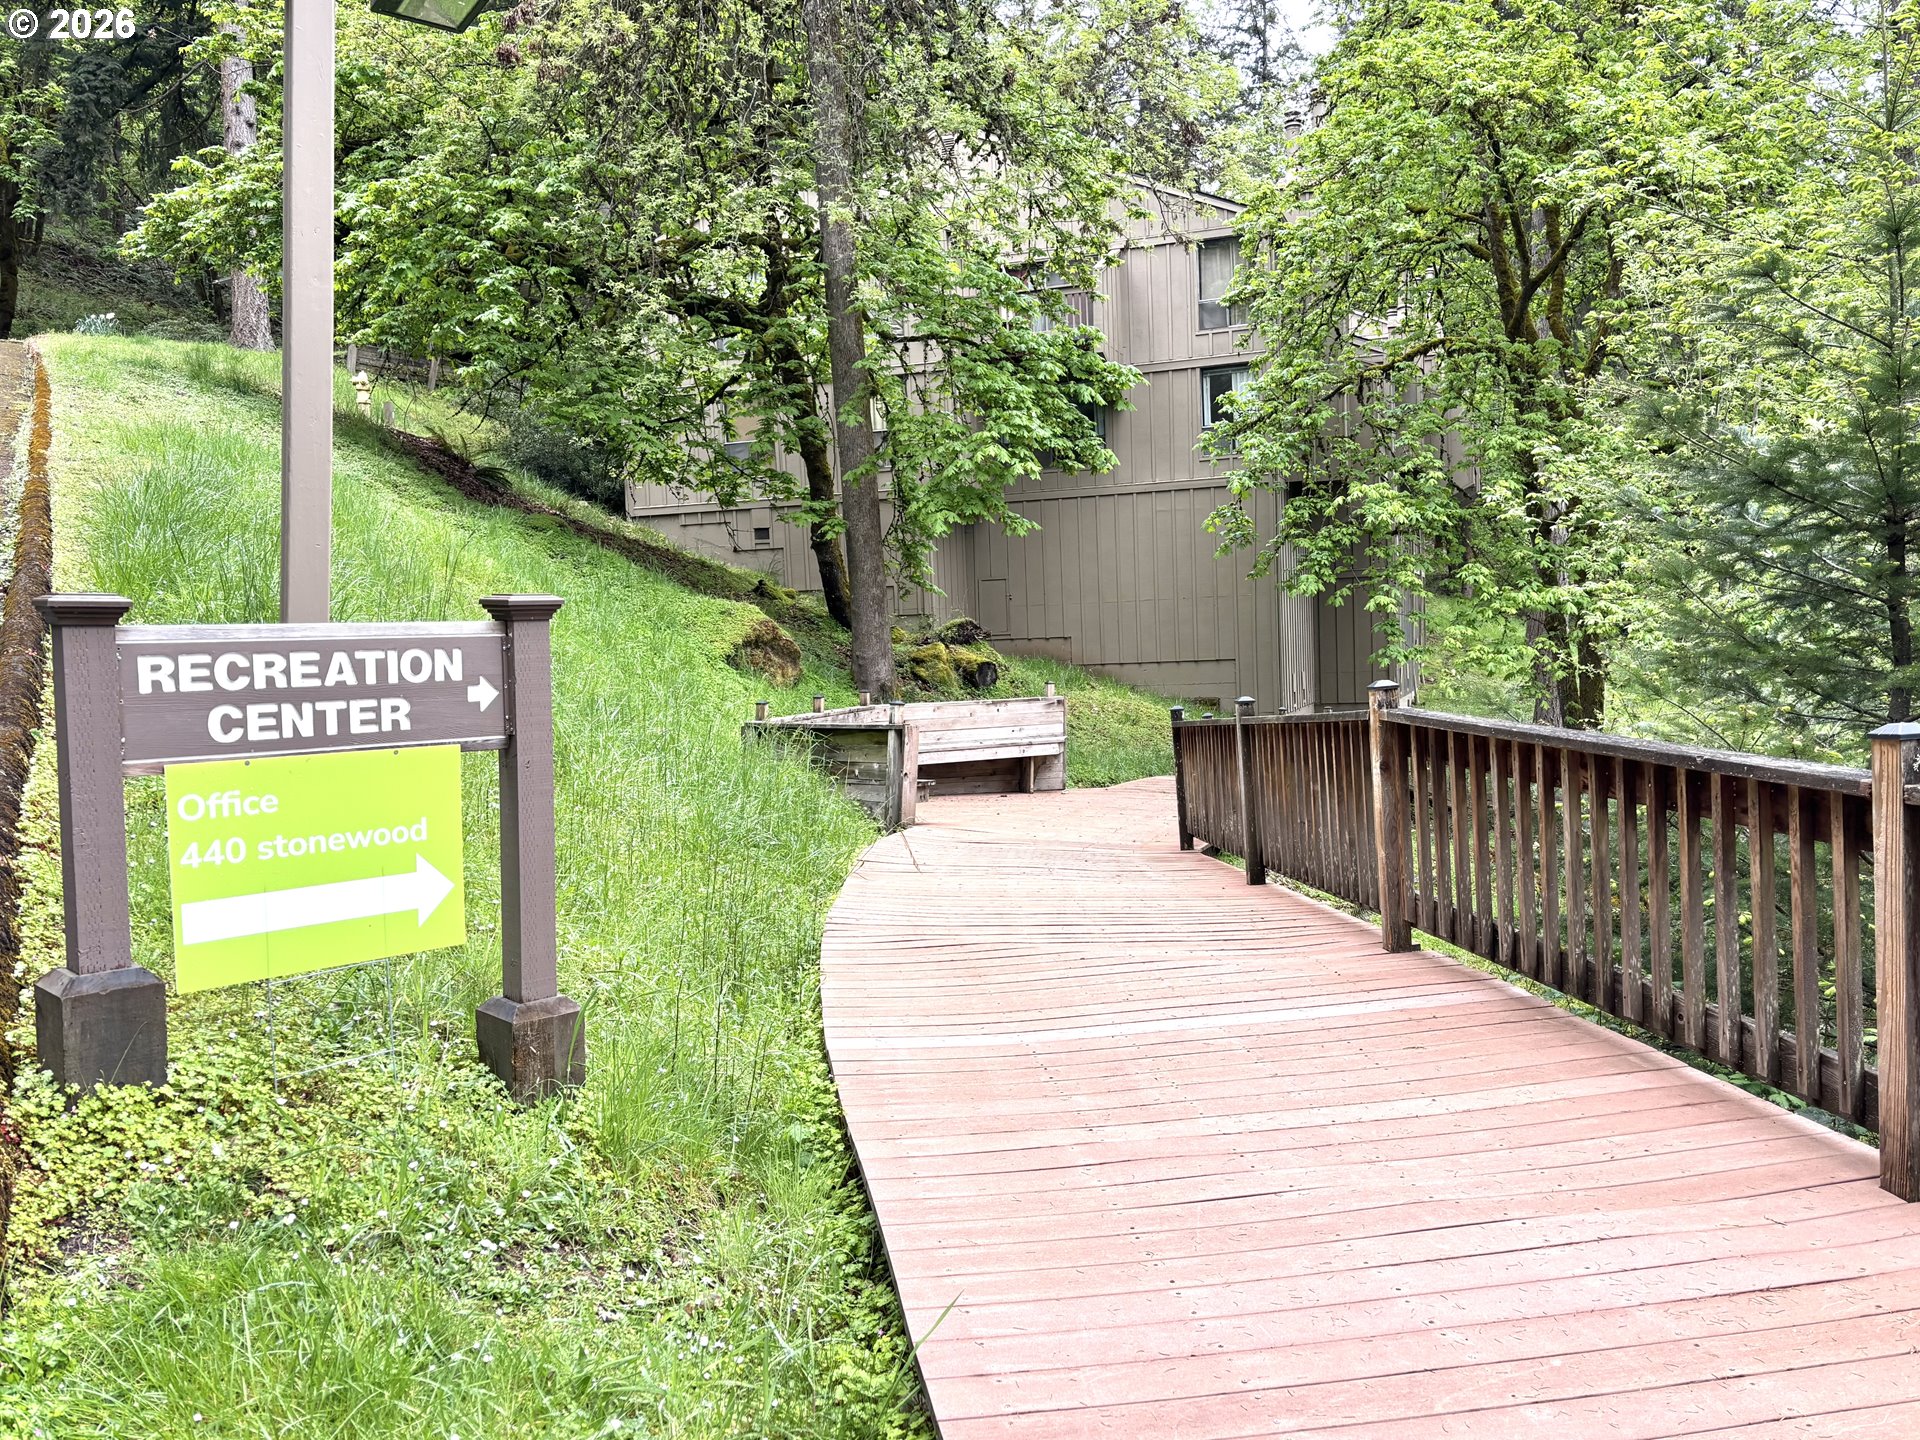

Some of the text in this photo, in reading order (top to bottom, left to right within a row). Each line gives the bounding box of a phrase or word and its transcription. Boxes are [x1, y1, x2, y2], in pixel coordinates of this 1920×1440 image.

[136, 647, 463, 695] RECREATION
[207, 697, 412, 744] CENTER
[177, 790, 279, 822] Office
[179, 816, 428, 869] 440 stonewood
